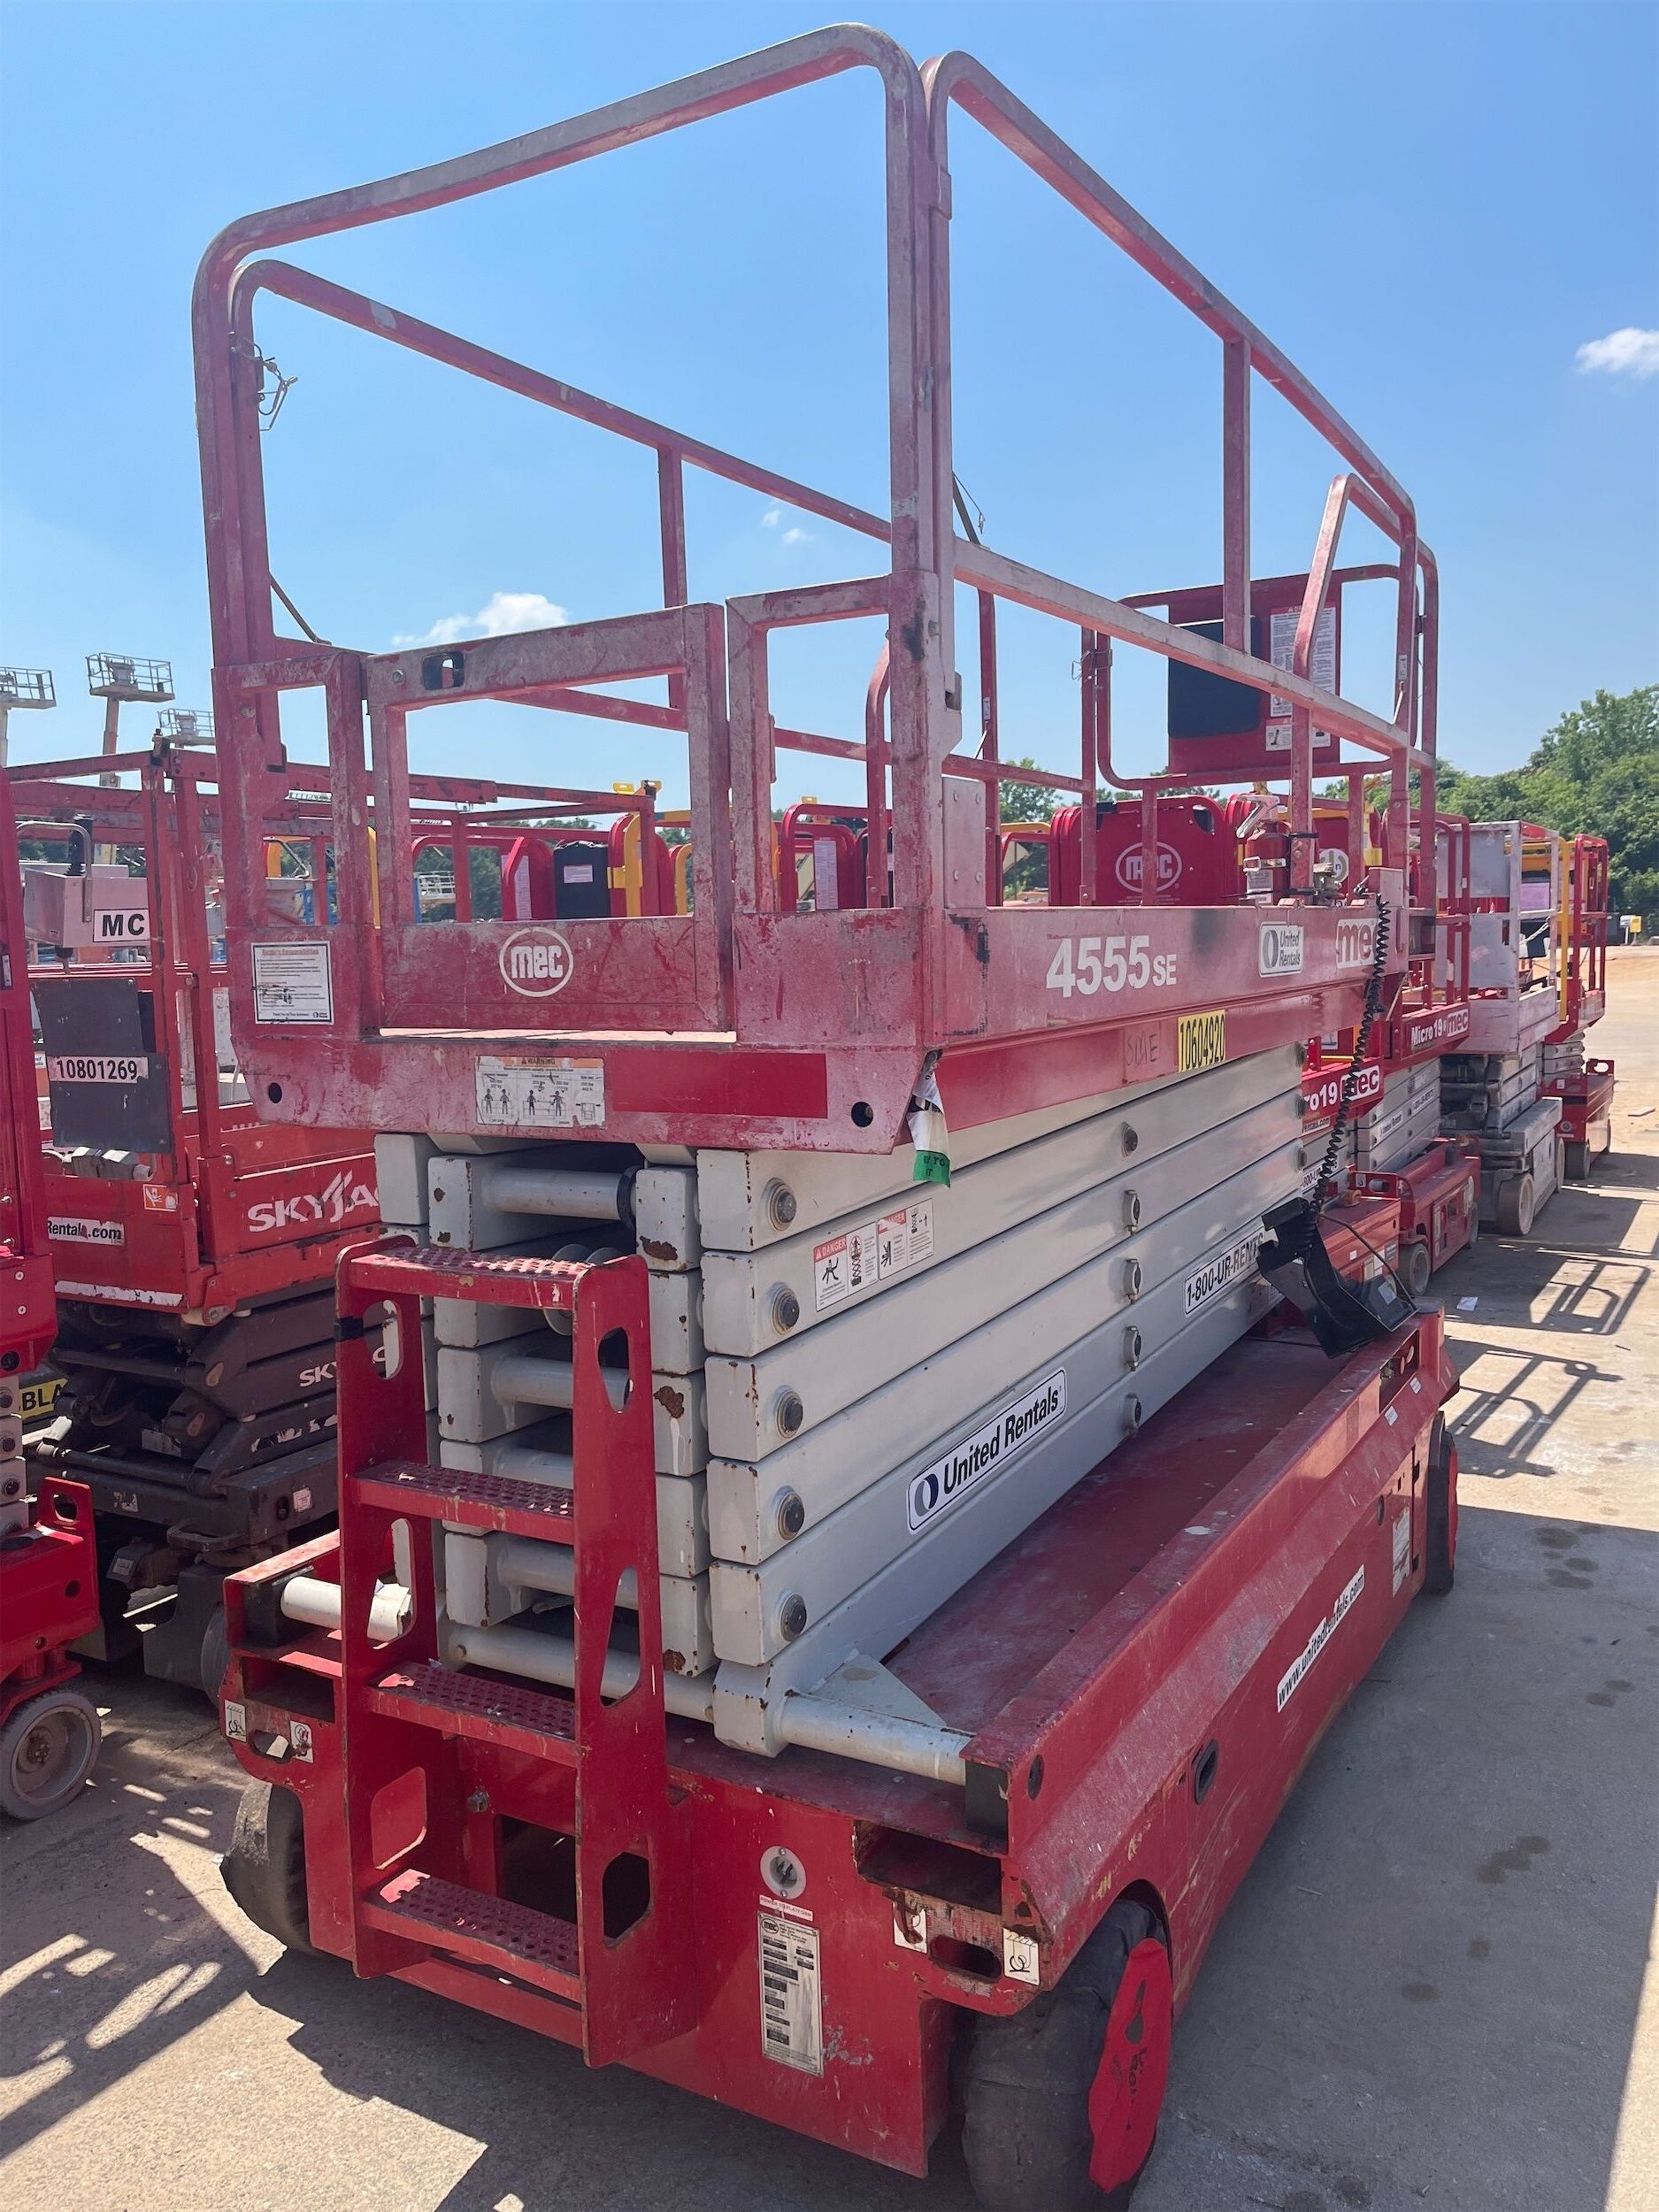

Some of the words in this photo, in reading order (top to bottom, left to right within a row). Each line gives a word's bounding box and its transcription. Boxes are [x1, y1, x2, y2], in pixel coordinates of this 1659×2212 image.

[102, 913, 145, 936] MC
[1279, 931, 1300, 948] United
[1279, 950, 1301, 967] Rentals
[1179, 1014, 1225, 1071] 10604920
[57, 1059, 138, 1080] 10801269
[822, 1238, 846, 1256] DANGER
[944, 1425, 1001, 1494] United
[1004, 1386, 1058, 1448] Rentals
